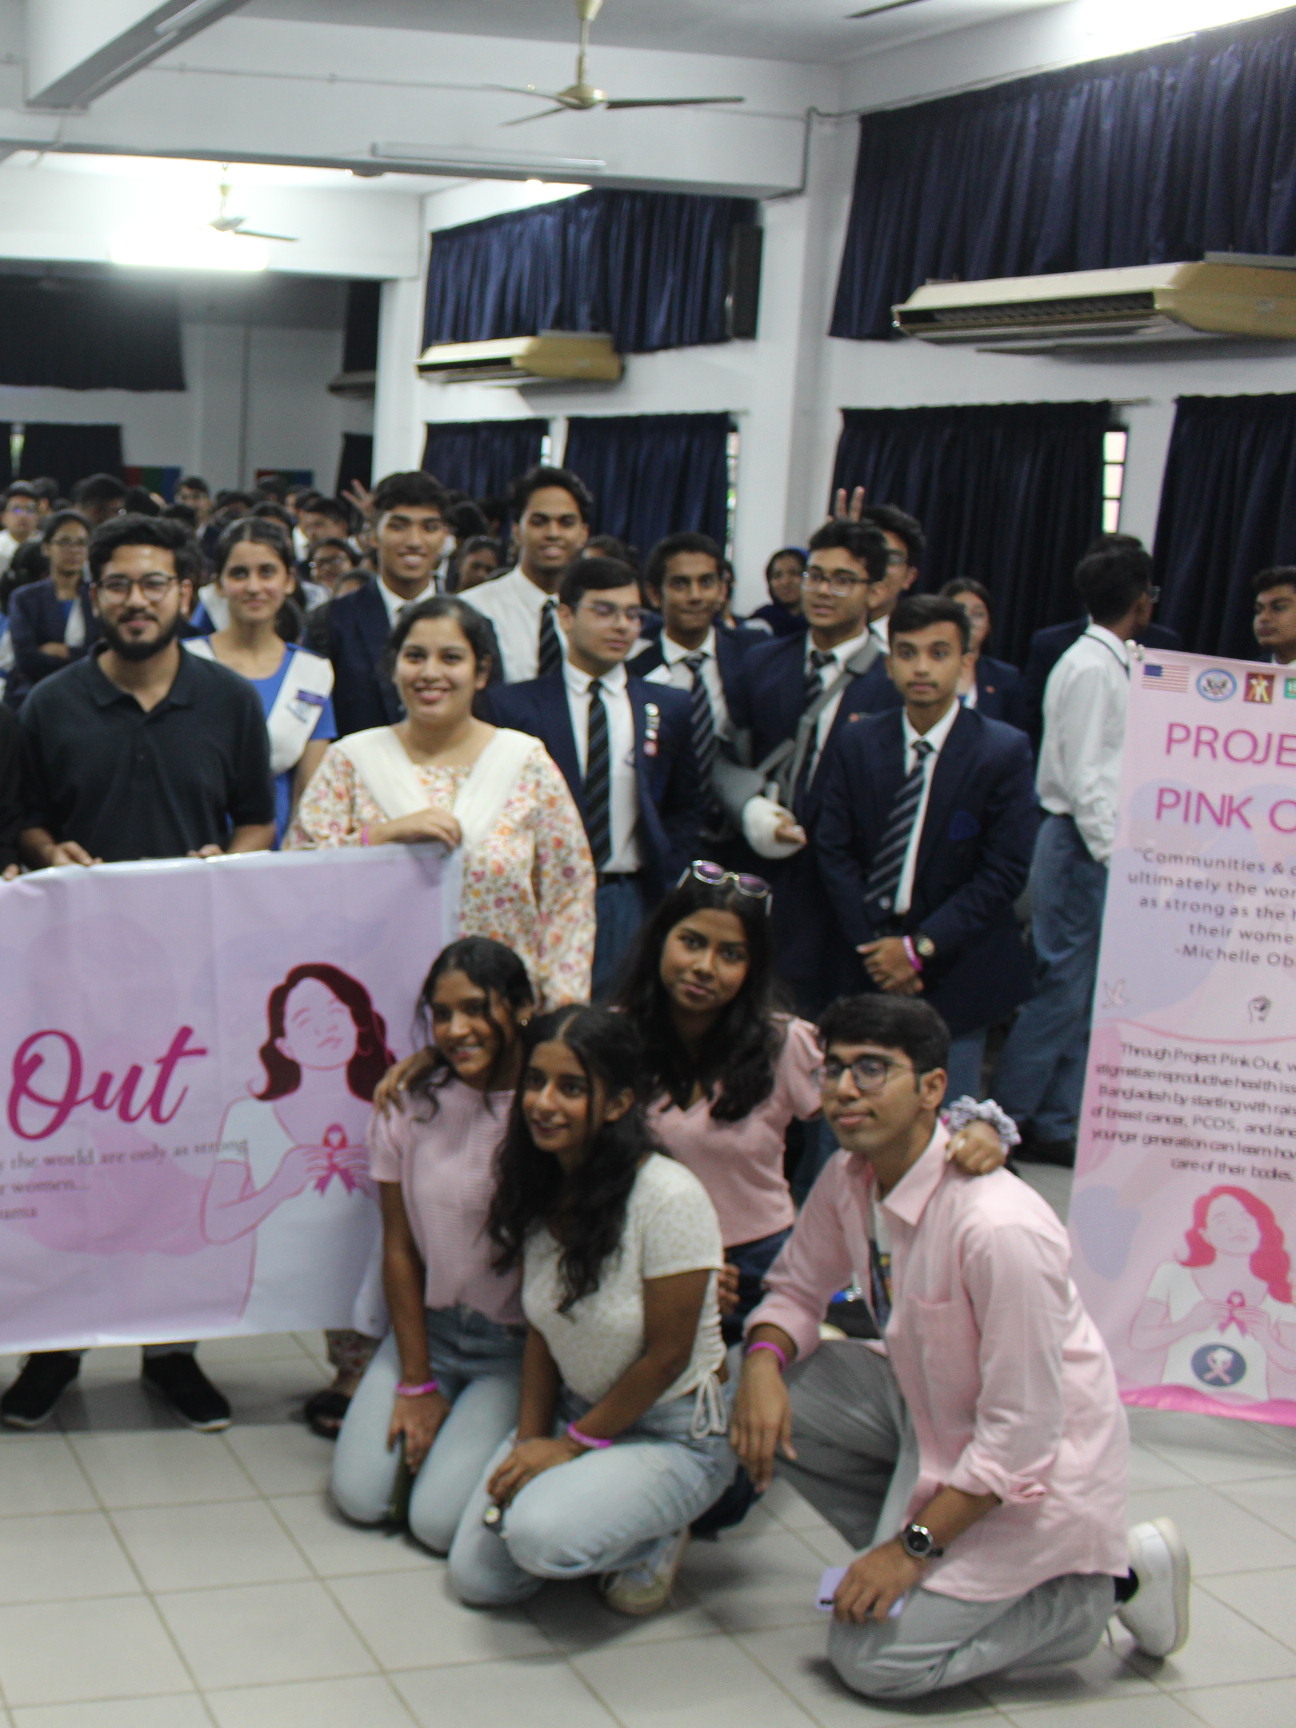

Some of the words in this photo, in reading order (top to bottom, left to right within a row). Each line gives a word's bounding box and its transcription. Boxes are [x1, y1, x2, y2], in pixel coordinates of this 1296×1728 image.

[1155, 786, 1254, 830] PINK
[1272, 861, 1284, 875] &
[1128, 870, 1220, 894] ultimately
[1227, 880, 1257, 896] the
[1139, 896, 1158, 909] as
[1164, 898, 1225, 918] strong
[1230, 905, 1249, 918] as
[1256, 905, 1286, 921] the
[1189, 922, 1232, 938] their
[1175, 944, 1260, 964] -Michelle
[1121, 1042, 1172, 1061] Through
[1174, 1047, 1217, 1065] Project
[1220, 1052, 1250, 1067] Pink
[8, 1026, 207, 1141] Out
[1157, 1070, 1233, 1089] reproductive
[1235, 1076, 1277, 1092] health
[1098, 1084, 1171, 1101] Bangladesh
[1174, 1092, 1187, 1106] by
[1191, 1095, 1241, 1113] starting
[1243, 1100, 1272, 1114] with
[1091, 1104, 1104, 1119] of
[1106, 1106, 1143, 1122] breast
[1244, 1122, 1272, 1136] and
[1091, 1128, 1138, 1145] younger
[1142, 1132, 1207, 1151] generation
[1209, 1140, 1234, 1153] can
[1237, 1141, 1272, 1157] learn
[10, 1151, 38, 1170] the
[43, 1147, 95, 1167] world
[99, 1151, 126, 1164] are
[130, 1143, 166, 1165] only
[174, 1146, 189, 1157] as
[1171, 1157, 1200, 1171] care
[1201, 1159, 1214, 1173] of
[1217, 1161, 1246, 1176] their
